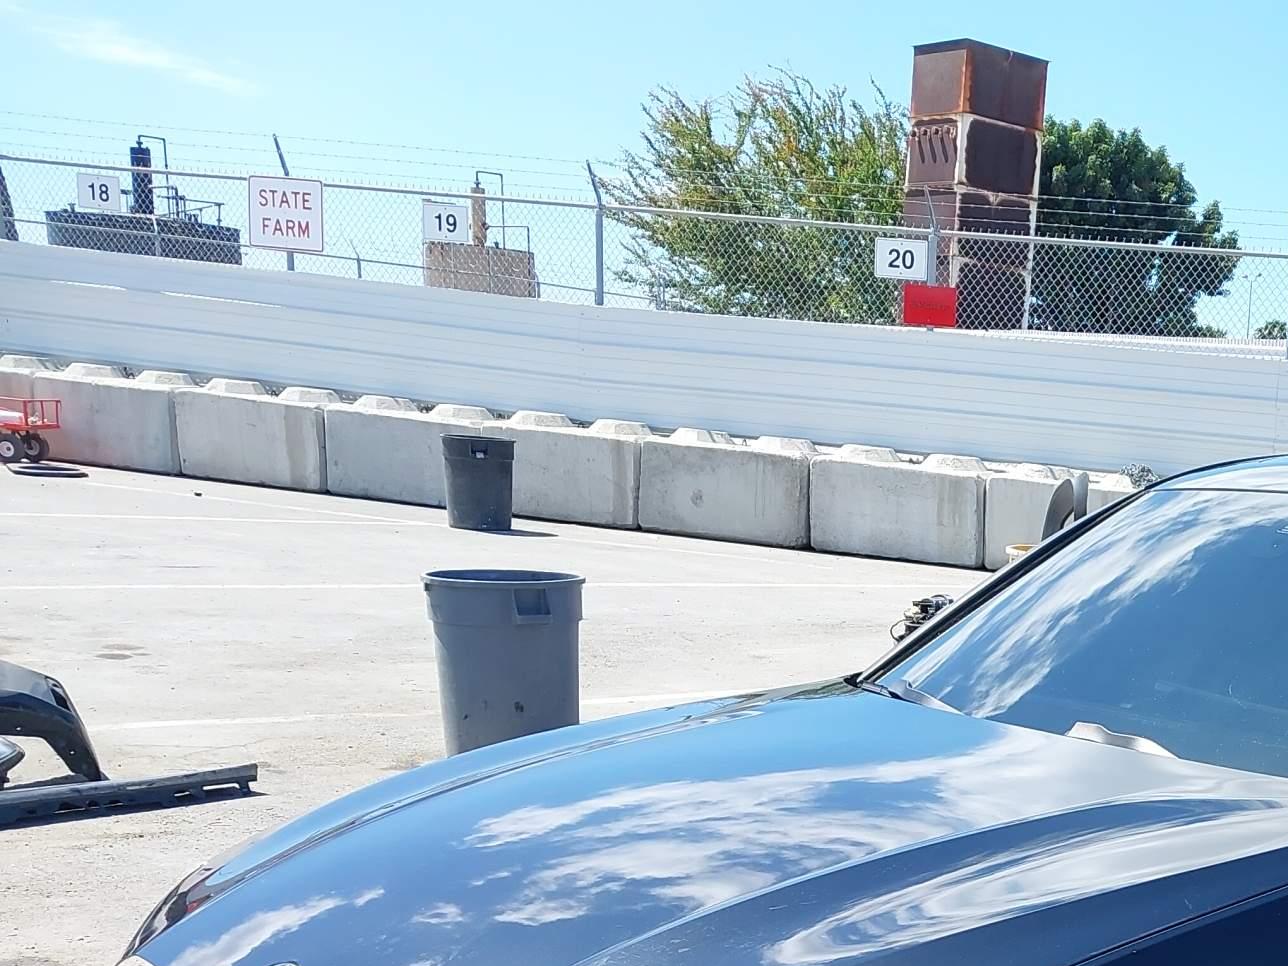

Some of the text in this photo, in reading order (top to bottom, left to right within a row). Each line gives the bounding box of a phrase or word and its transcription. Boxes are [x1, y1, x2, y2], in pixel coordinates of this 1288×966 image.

[88, 182, 110, 202] 18
[258, 188, 312, 211] STATE
[262, 217, 310, 239] FARM
[434, 213, 457, 233] 19
[887, 248, 915, 270] 20
